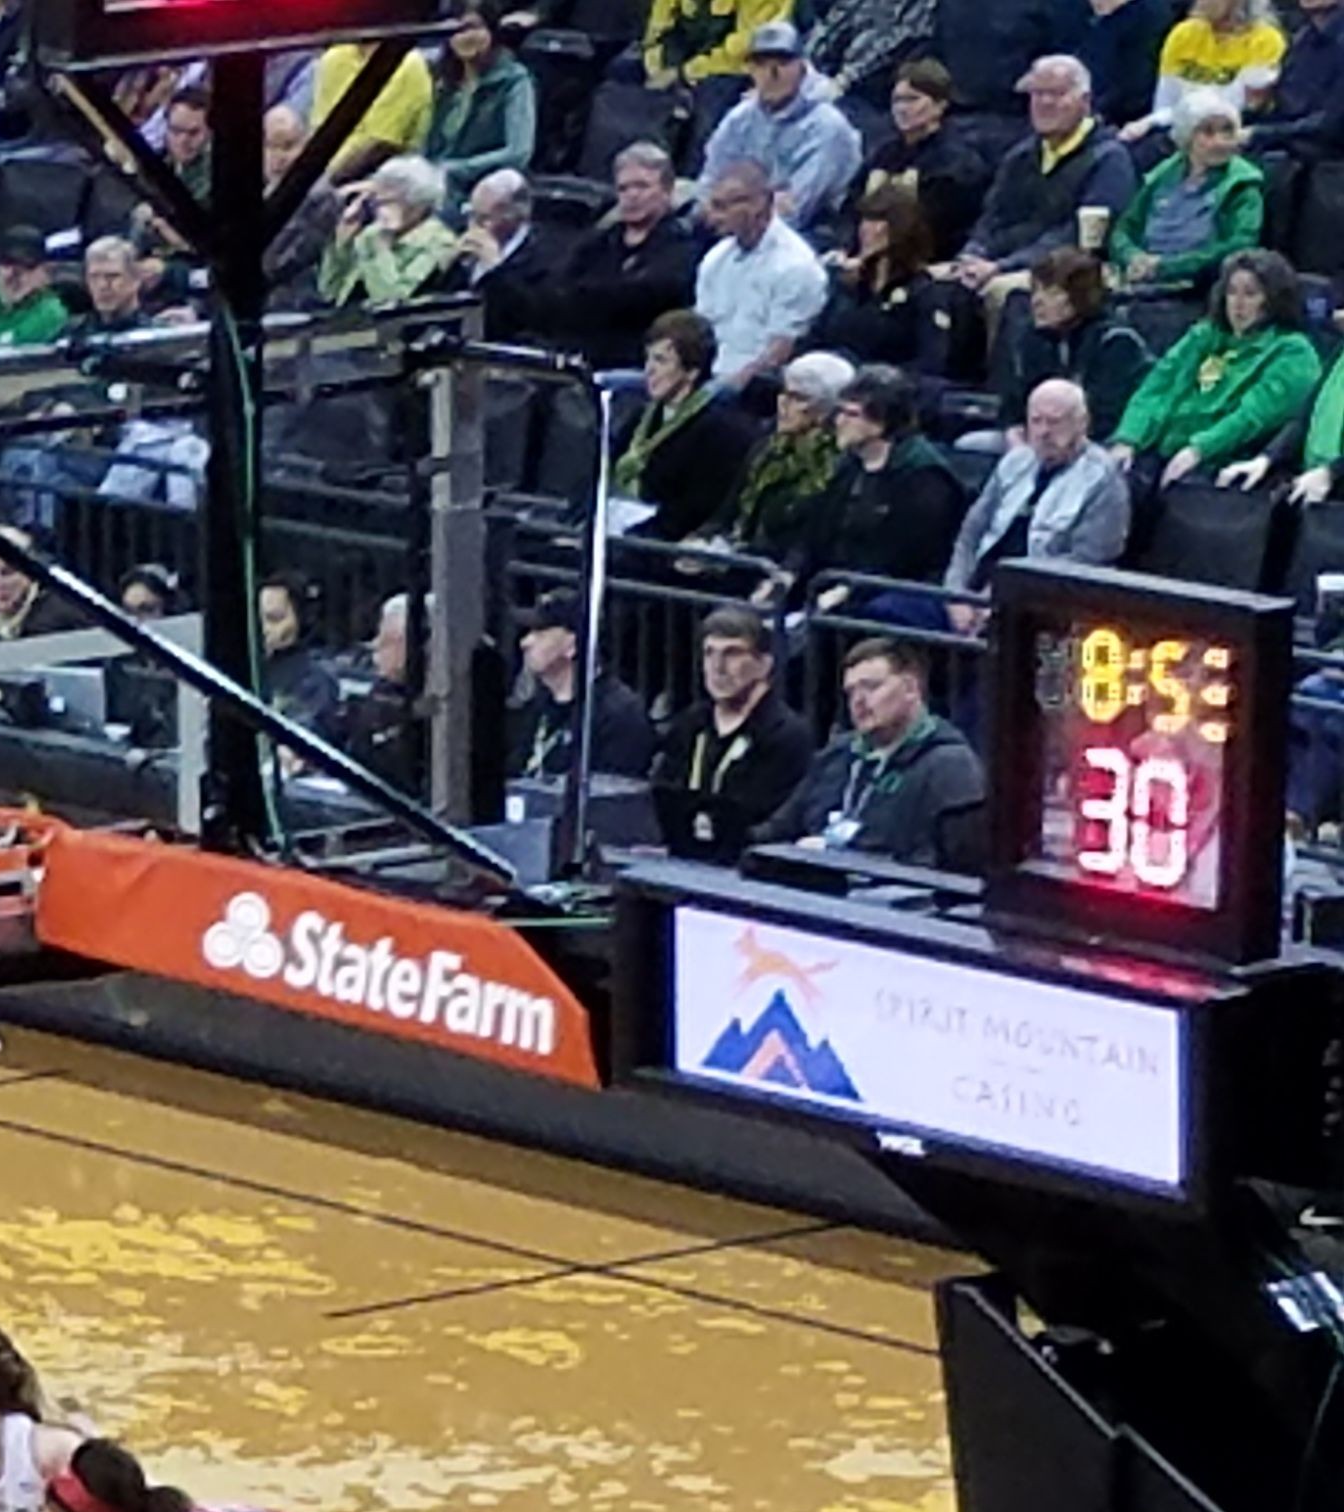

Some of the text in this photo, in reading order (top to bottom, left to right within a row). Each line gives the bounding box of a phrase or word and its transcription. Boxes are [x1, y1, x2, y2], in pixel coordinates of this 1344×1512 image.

[1077, 747, 1188, 888] 30
[874, 988, 1160, 1076] SPIRIT MOUNTAIN
[952, 1076, 1082, 1126] CASINO
